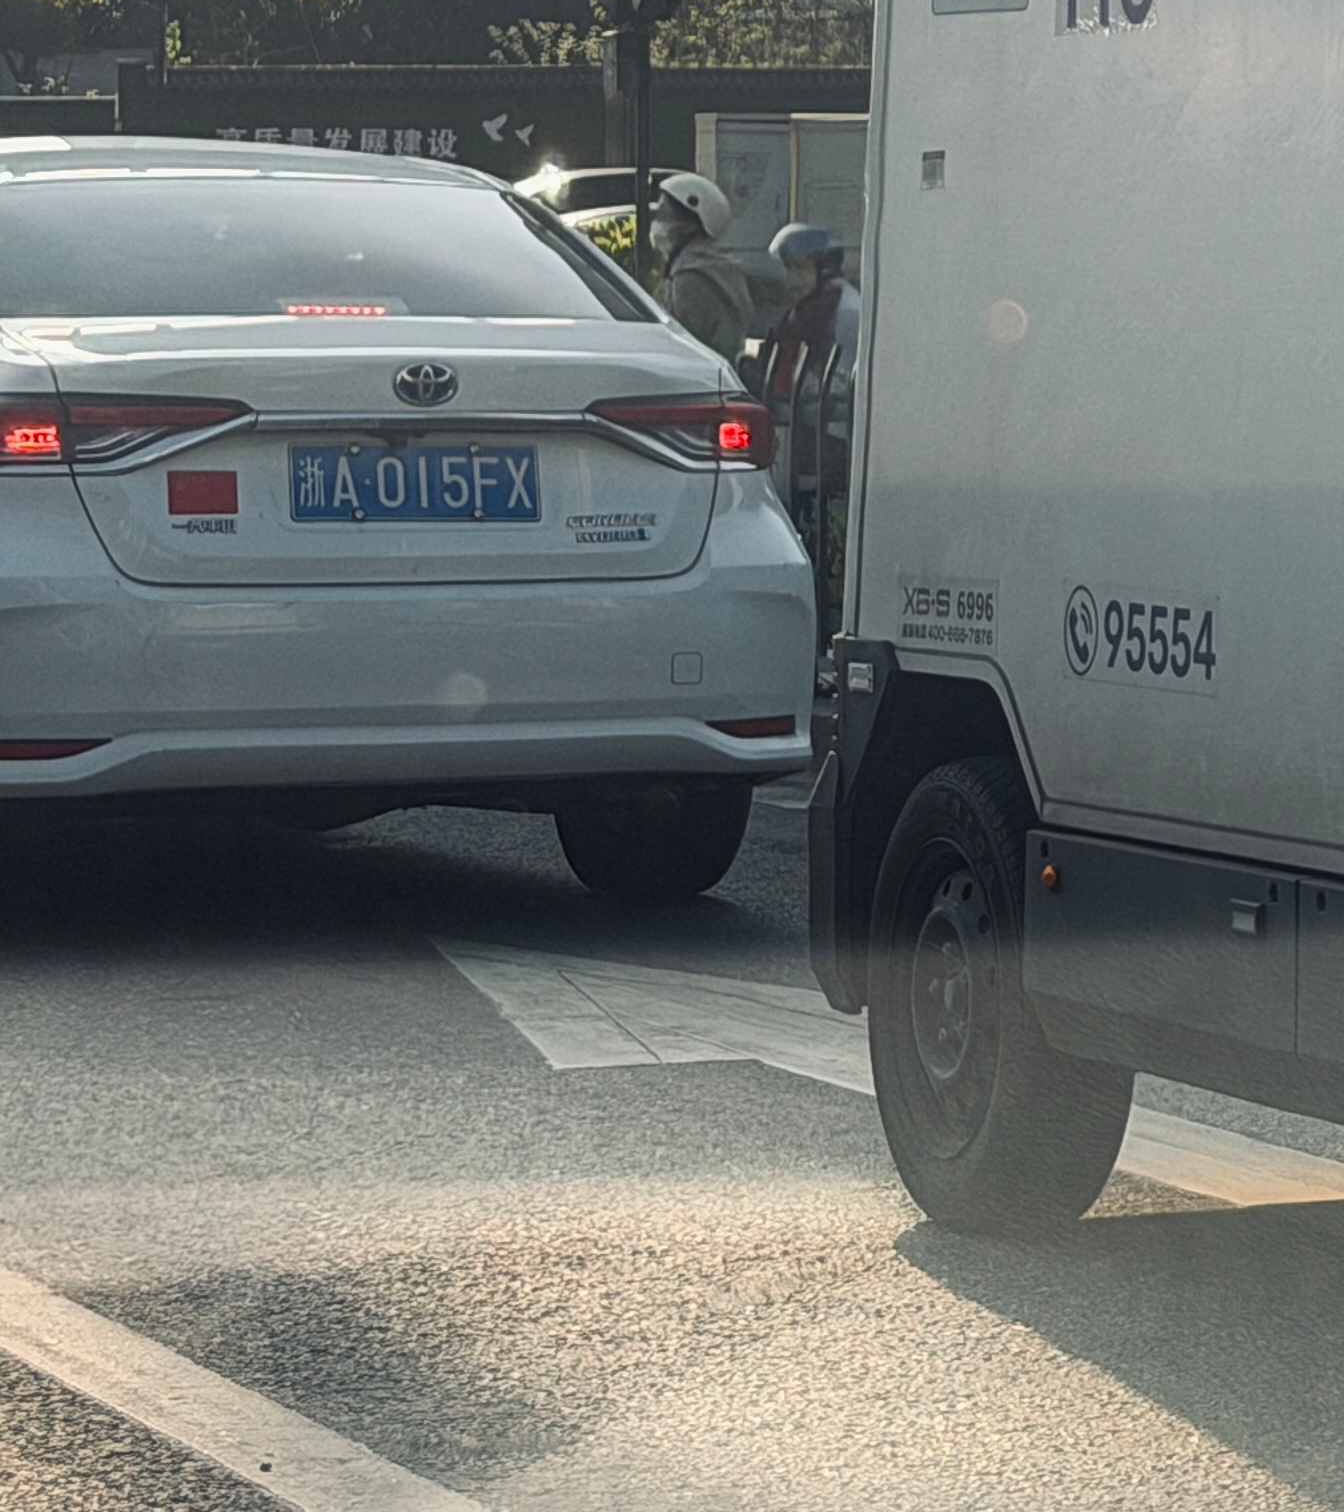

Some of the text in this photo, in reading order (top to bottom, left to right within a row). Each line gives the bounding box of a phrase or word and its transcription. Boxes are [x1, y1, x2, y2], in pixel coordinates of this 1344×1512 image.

[299, 454, 533, 509] 浙A·015FX
[956, 590, 994, 622] 6996
[1104, 599, 1217, 681] 95554
